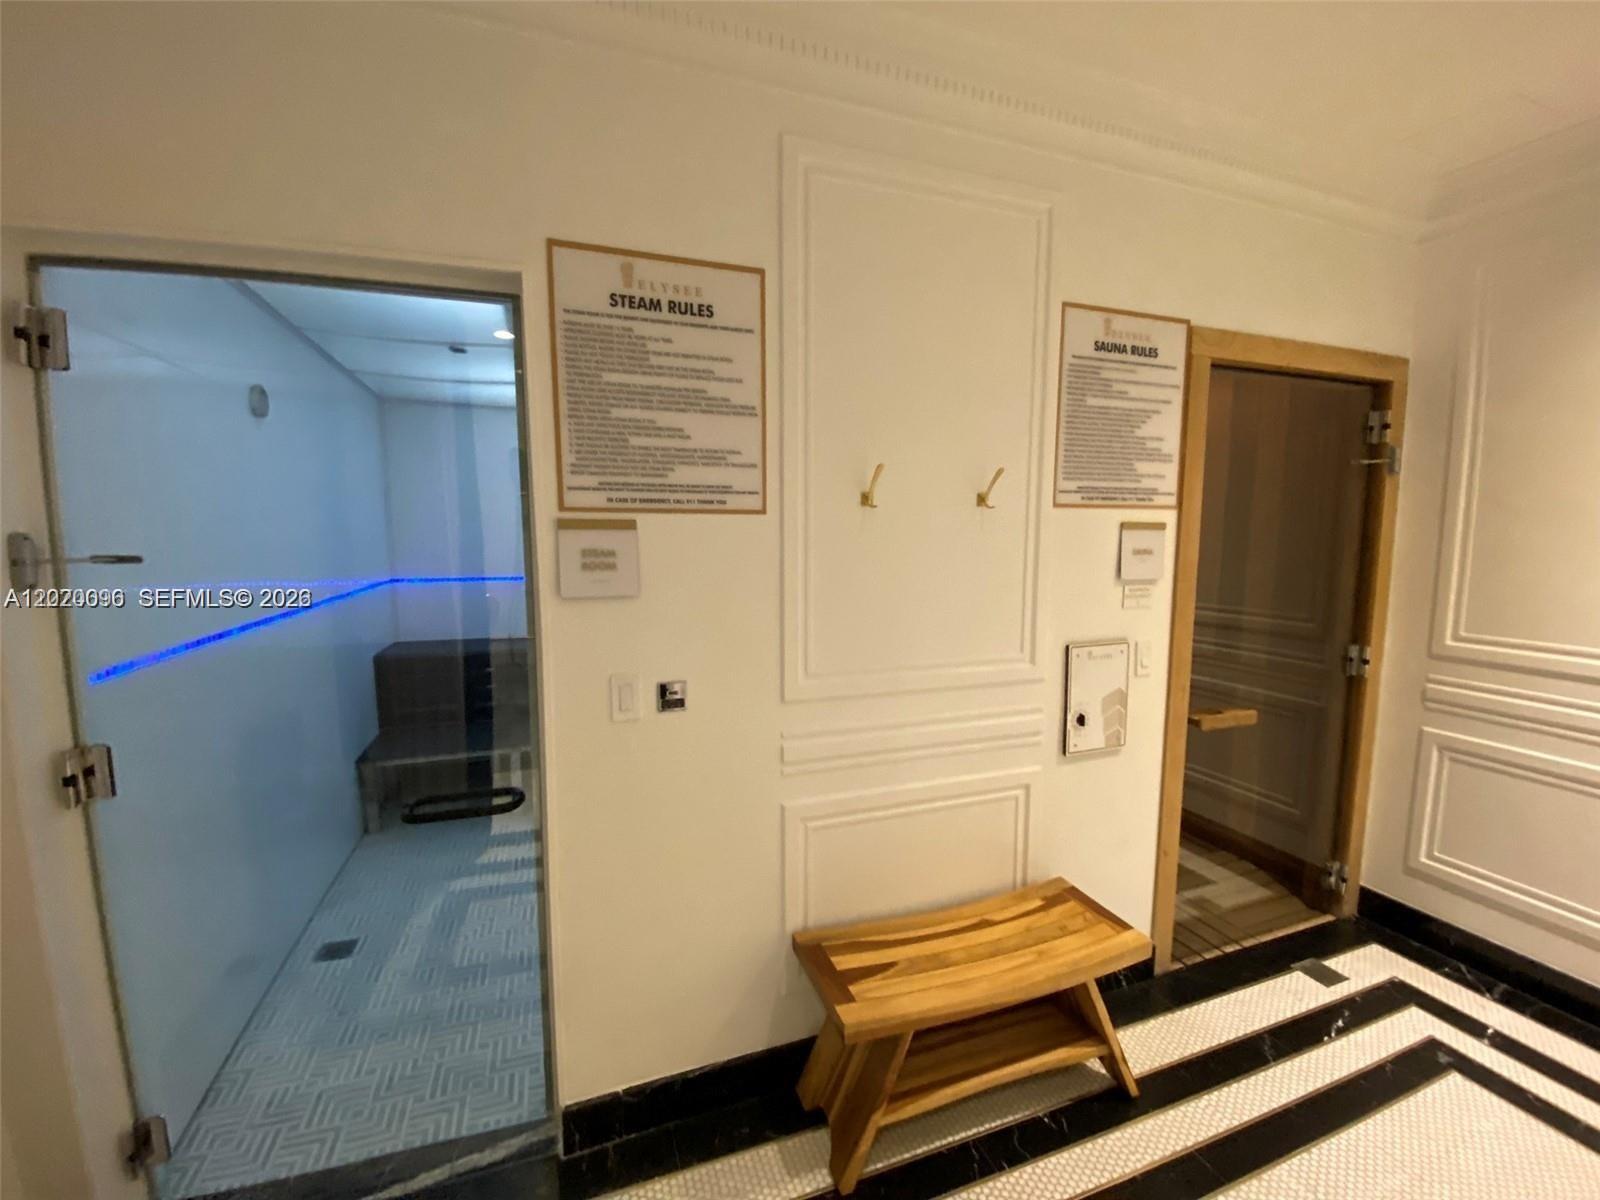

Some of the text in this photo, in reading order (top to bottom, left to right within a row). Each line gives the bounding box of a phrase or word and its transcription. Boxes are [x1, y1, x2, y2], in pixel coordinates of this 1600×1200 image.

[637, 279, 704, 298] ELYSEE
[609, 292, 714, 319] STEAM RULES
[1093, 340, 1159, 359] SAUNA RULES
